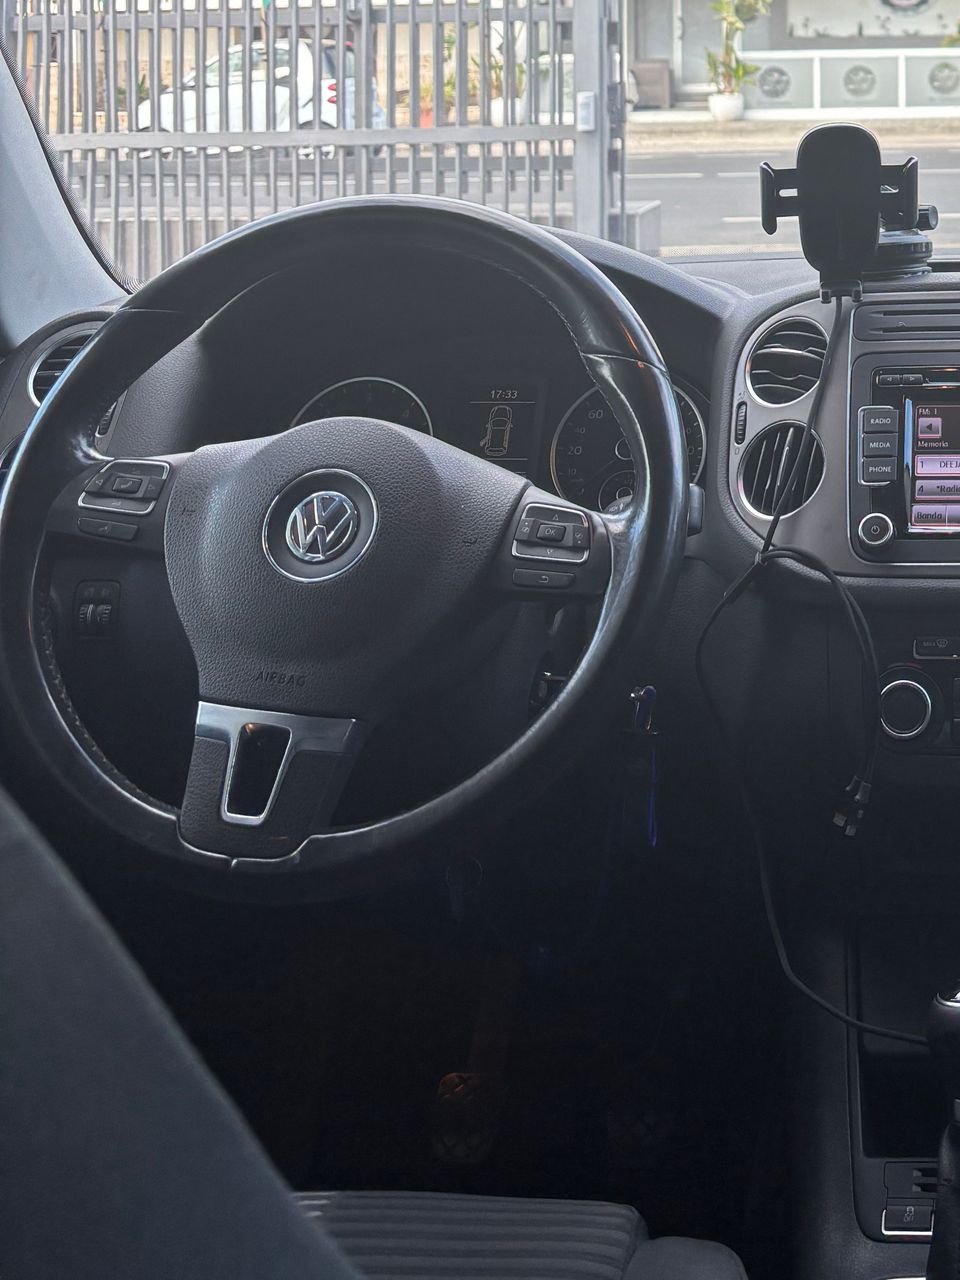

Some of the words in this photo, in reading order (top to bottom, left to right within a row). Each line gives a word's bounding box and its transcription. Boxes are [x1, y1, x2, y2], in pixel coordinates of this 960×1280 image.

[490, 390, 518, 398] 17:33
[587, 409, 603, 419] 60
[567, 446, 582, 455] 20
[545, 528, 556, 536] OK
[256, 671, 306, 686] AIRBAG
